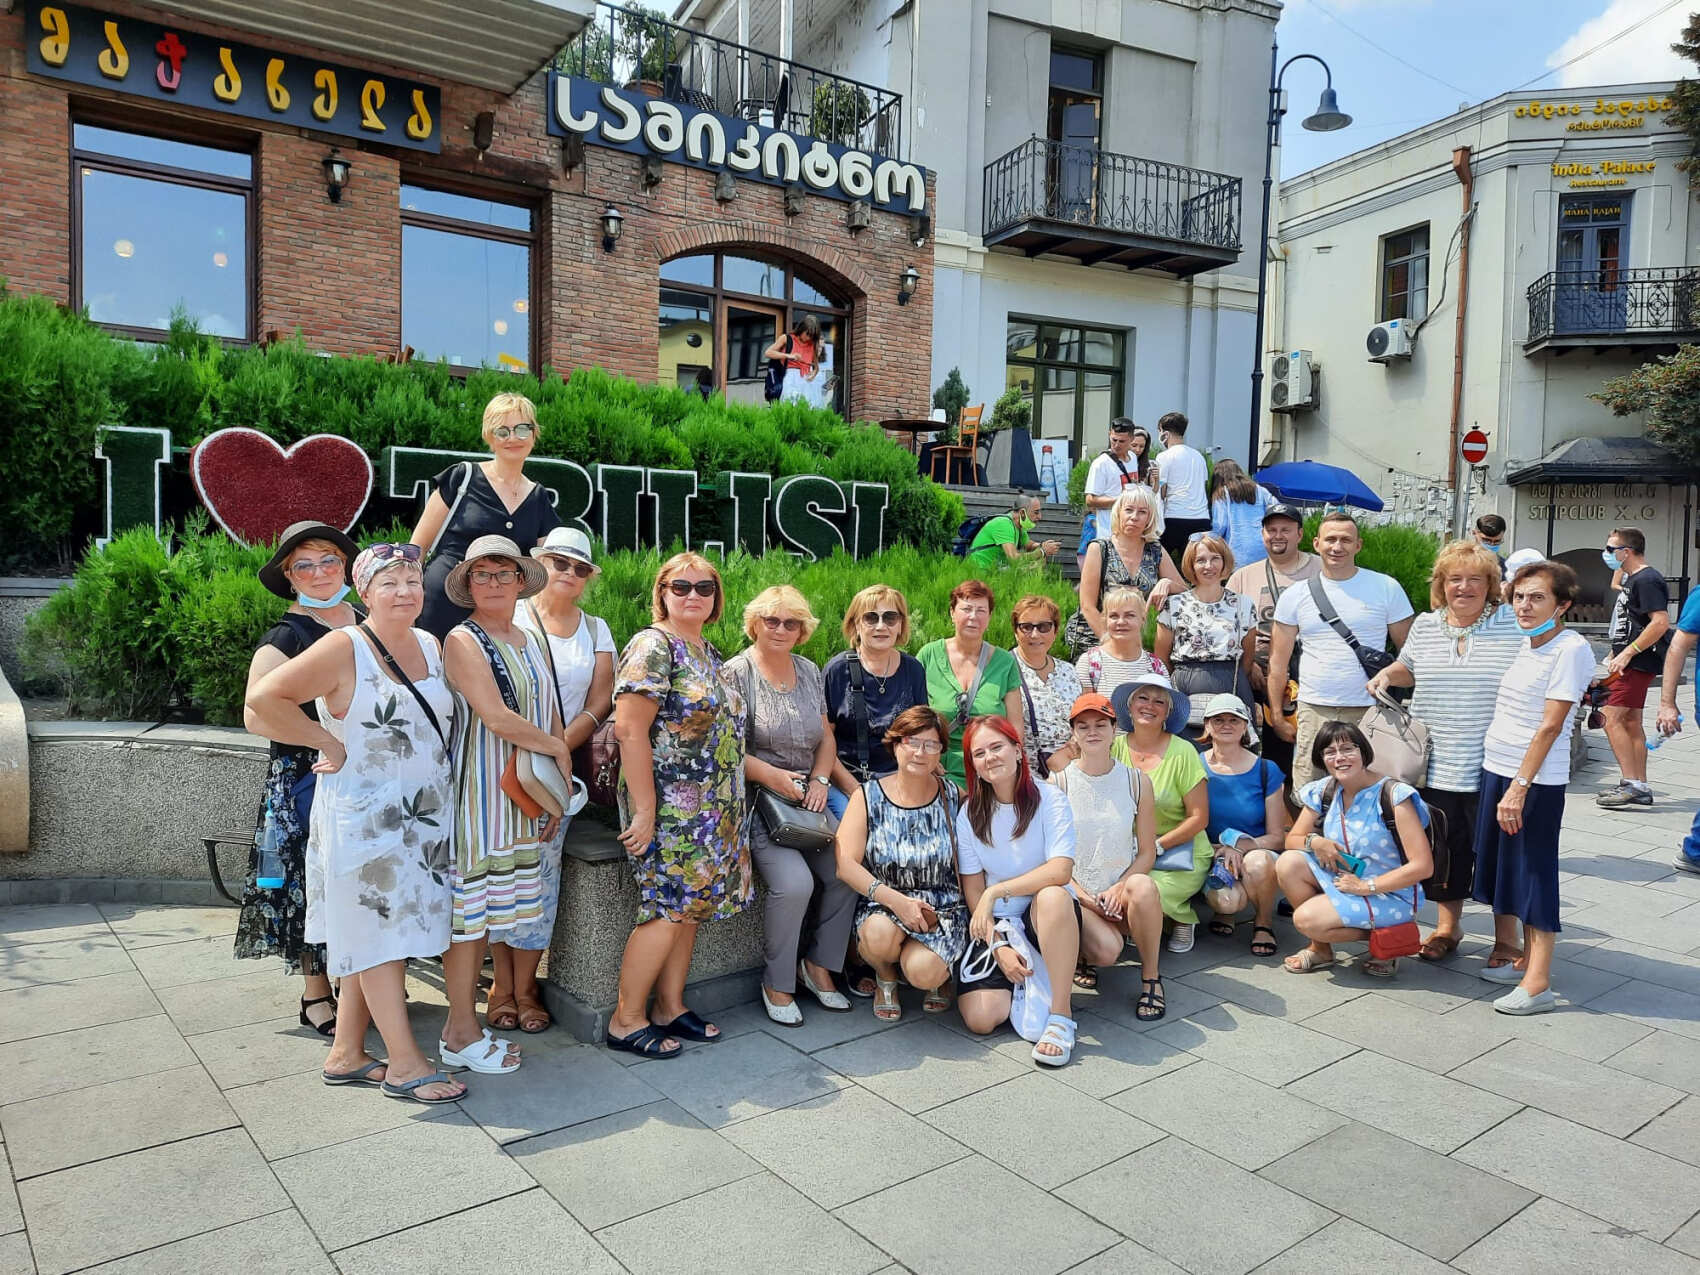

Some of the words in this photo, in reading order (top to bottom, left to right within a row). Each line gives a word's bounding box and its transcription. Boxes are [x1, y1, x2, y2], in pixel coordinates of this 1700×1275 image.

[40, 7, 433, 140] მაჭახელა
[554, 77, 926, 212] სამიკიტნო
[1552, 162, 1592, 176] India
[1600, 160, 1656, 175] Palace
[1528, 504, 1606, 521] STIPCLUB
